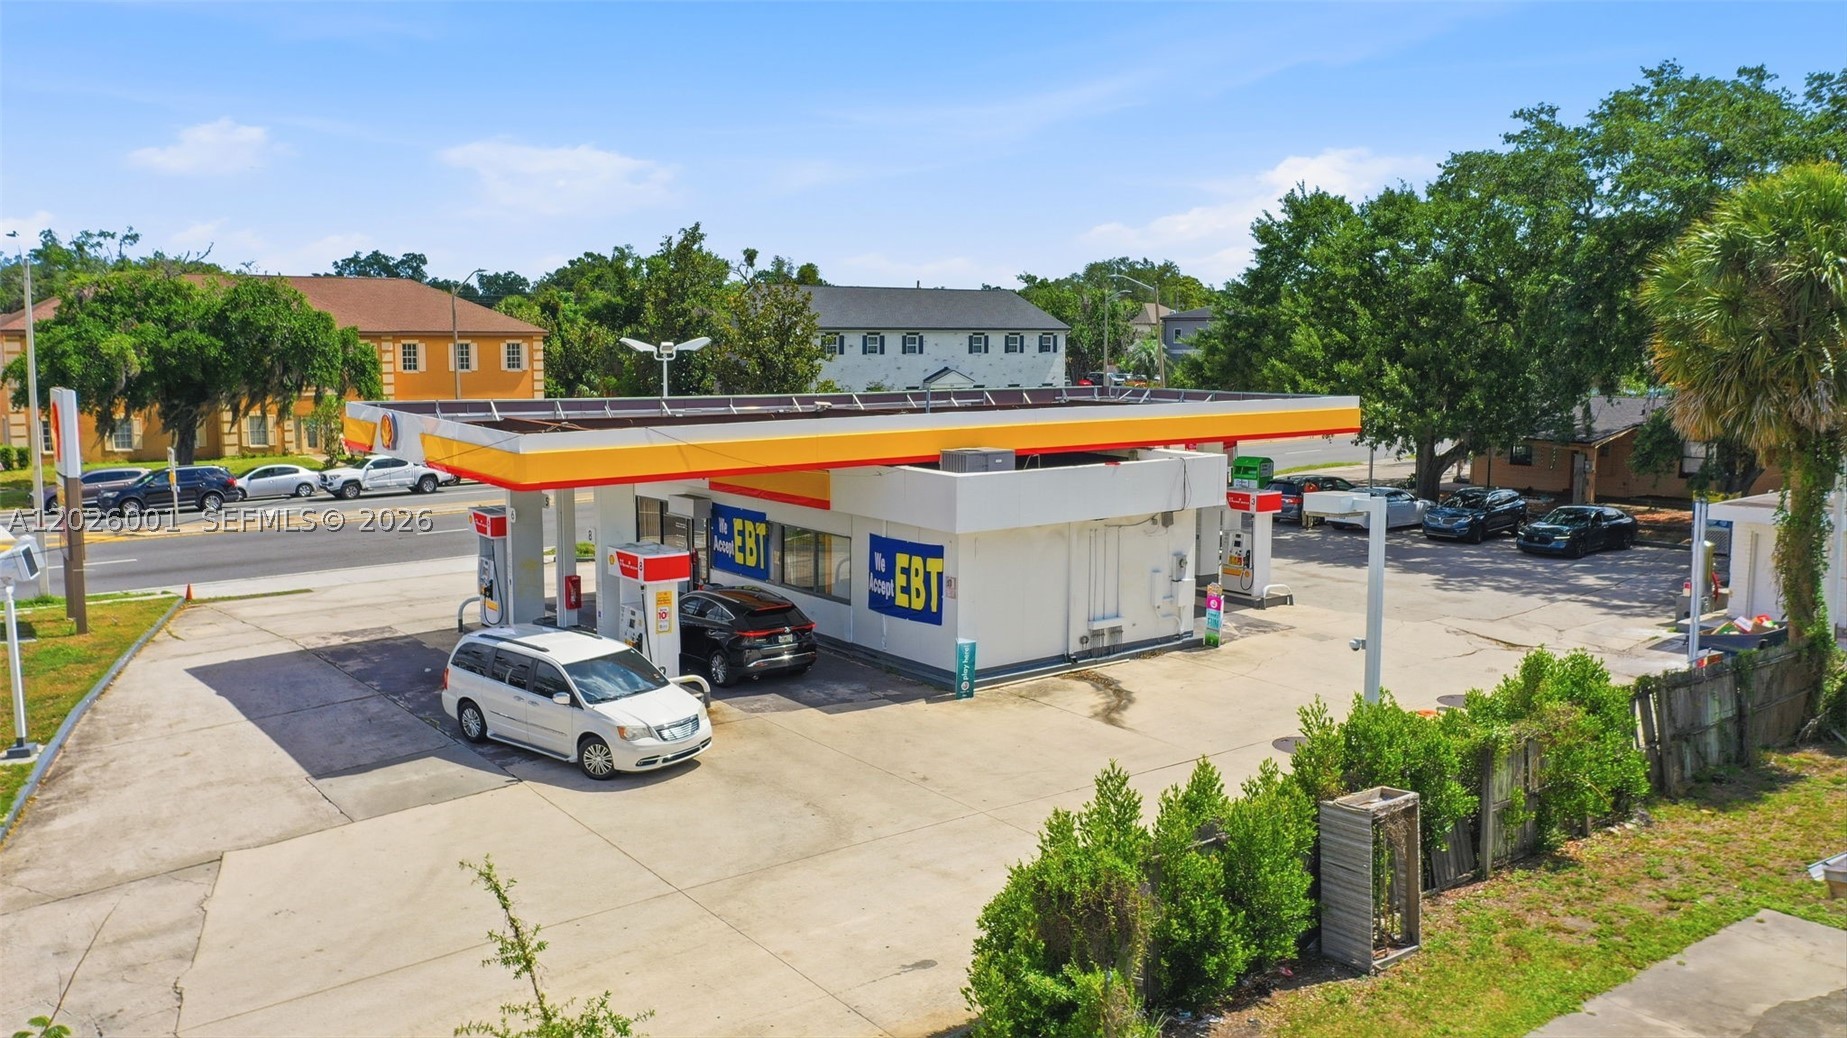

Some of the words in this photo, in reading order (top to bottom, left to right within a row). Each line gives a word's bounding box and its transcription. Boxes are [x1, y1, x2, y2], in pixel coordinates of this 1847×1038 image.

[1251, 498, 1256, 506] 3
[588, 529, 593, 541] 8
[718, 517, 728, 535] We
[713, 535, 735, 558] Accept
[732, 517, 767, 570] EBT
[638, 561, 643, 571] 8
[874, 551, 886, 573] We
[869, 572, 895, 600] Accept
[895, 552, 944, 613] EBT
[961, 664, 970, 681] play
